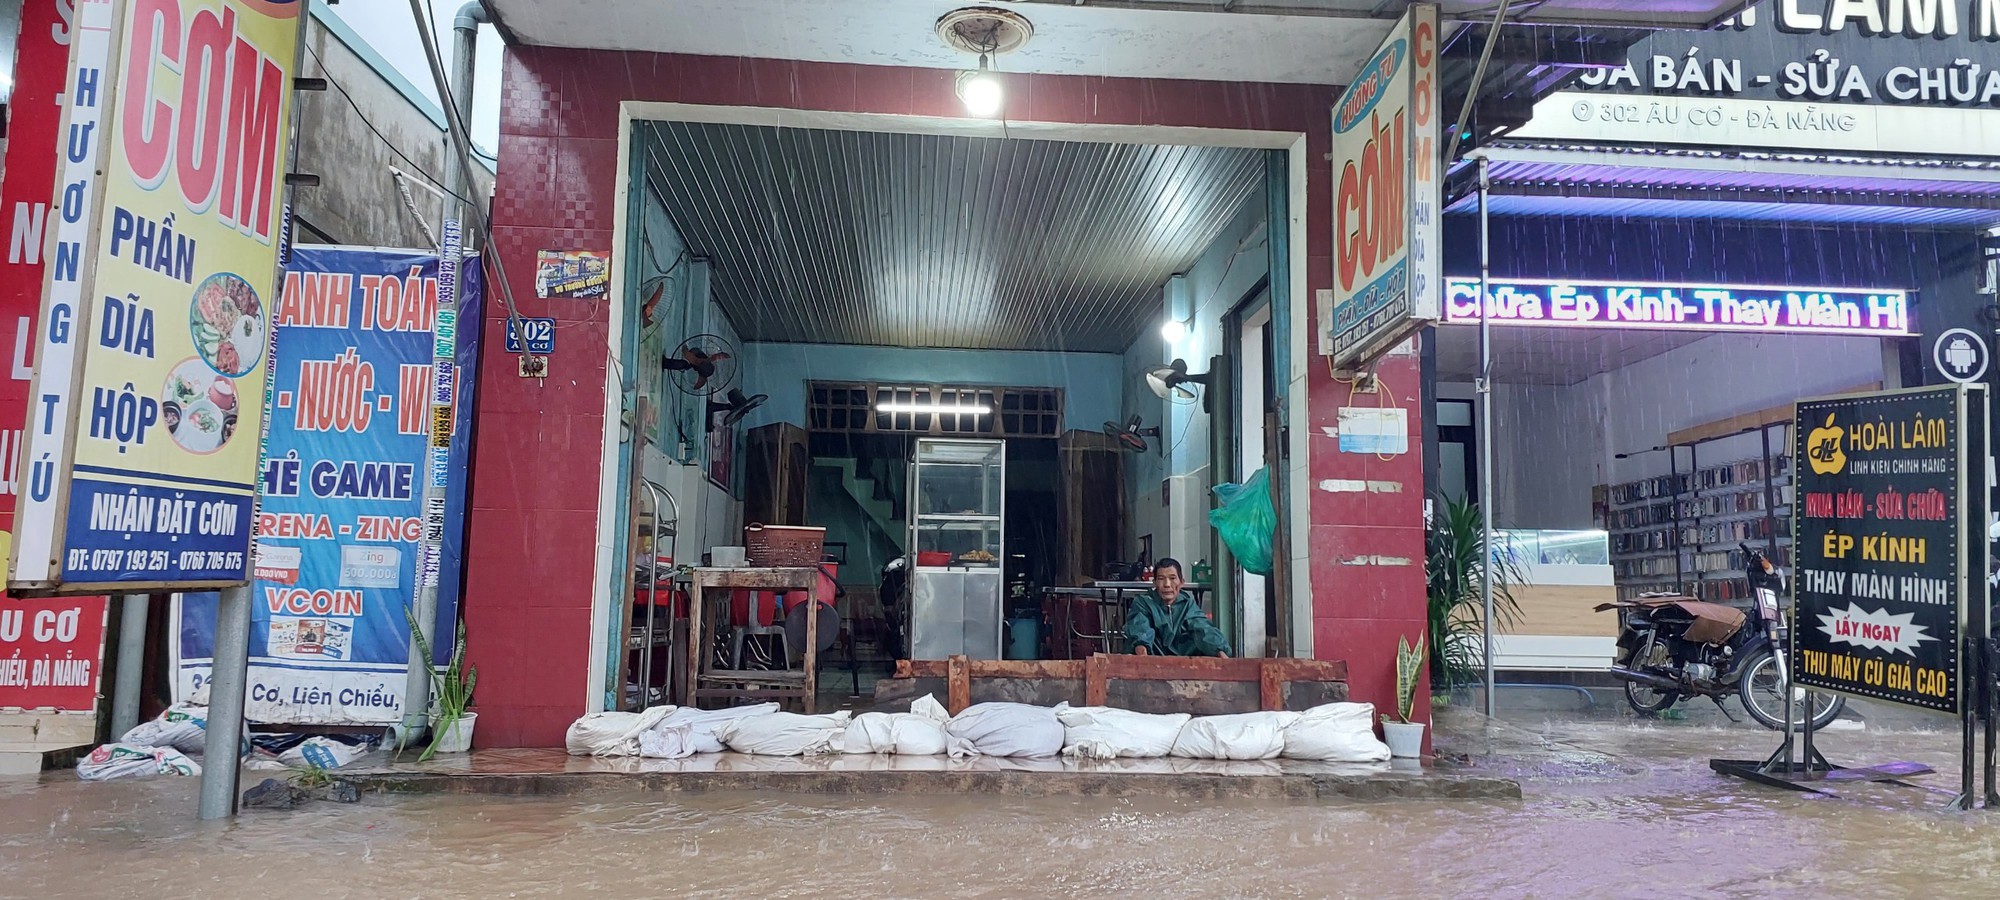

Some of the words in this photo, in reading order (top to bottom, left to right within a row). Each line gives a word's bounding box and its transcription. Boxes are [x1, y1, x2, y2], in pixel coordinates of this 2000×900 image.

[1571, 60, 1640, 87] UA
[1653, 46, 1742, 92] BÁN
[1756, 75, 1771, 83] -
[1784, 49, 1872, 98] SỬA
[1885, 58, 2000, 102] CHỮA
[1415, 22, 1432, 181] CƠM
[1600, 103, 1639, 123] 302
[1688, 106, 1723, 127] CƠ
[1746, 105, 1779, 130] ĐÀ
[122, 0, 285, 245] CƠM
[49, 67, 99, 344] HƯƠNG
[1338, 106, 1404, 292] CƠM
[110, 206, 196, 285] PHẦN
[532, 341, 548, 349] CƠ
[296, 349, 373, 432] NƯỚC
[90, 382, 158, 453] HỘP
[1850, 414, 1894, 452] HOÀI
[1901, 411, 1946, 449] LÂM
[31, 394, 60, 503] TÚ
[1850, 462, 1868, 475] LINH
[1870, 459, 1890, 477] KIỆN
[1892, 455, 1919, 475] CHÍNH
[1921, 454, 1946, 474] HÃNG
[310, 460, 413, 500] GAME
[90, 488, 151, 540] NHẬN
[156, 492, 196, 541] ĐẶT
[199, 500, 238, 536] CƠM
[1806, 492, 1833, 518] MUA
[1836, 488, 1863, 519] BÁN
[1876, 484, 1903, 520] SỬA
[1907, 487, 1946, 520] CHỮA
[355, 515, 422, 543] ZING
[1823, 529, 1854, 558] ÉP
[1862, 531, 1926, 563] KÍNH
[68, 549, 89, 571] ĐT:
[92, 550, 122, 571] 0797
[126, 551, 147, 571] 193
[150, 552, 169, 571] 251
[180, 552, 203, 571] 0766
[206, 552, 223, 571] 705
[225, 553, 242, 571] 675
[265, 587, 362, 616] VCOIN
[1804, 570, 1846, 594] THAY
[1851, 570, 1894, 600] MÀN
[1901, 572, 1947, 605] HÌNH
[33, 607, 81, 642] CƠ
[1835, 614, 1859, 637] LẤY
[1862, 625, 1901, 642] NGAY
[32, 653, 50, 686] ĐÀ
[52, 649, 91, 687] NẴNG
[1803, 650, 1828, 676] THU
[1831, 651, 1860, 682] MÁY
[1864, 657, 1883, 686] CŨ
[1887, 660, 1912, 691] GIÁ
[1916, 668, 1947, 698] CAO
[252, 683, 283, 706] Cơ,
[292, 686, 331, 705] Liên
[338, 683, 400, 711] Chiểu,
